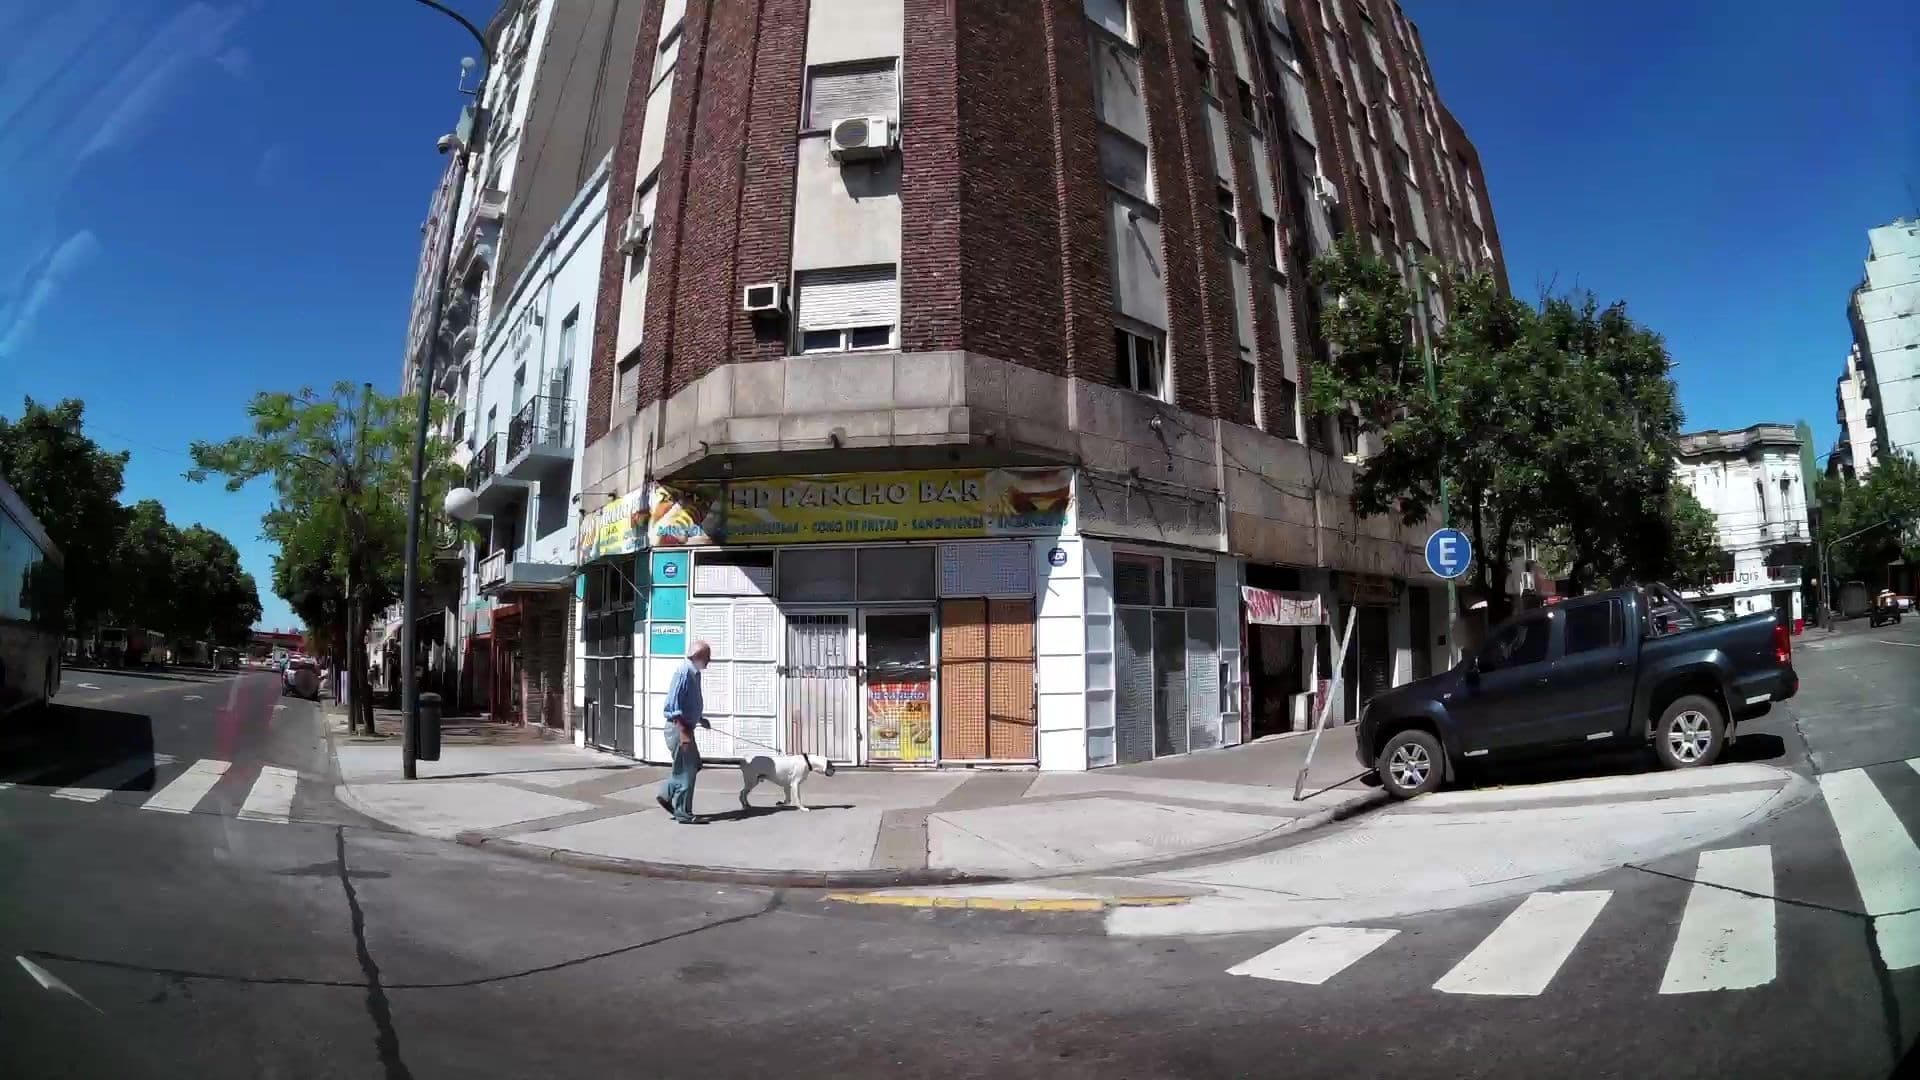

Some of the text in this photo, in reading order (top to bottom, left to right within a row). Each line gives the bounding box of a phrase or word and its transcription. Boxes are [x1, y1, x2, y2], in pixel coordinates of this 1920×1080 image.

[782, 481, 911, 508] PANCHO
[918, 479, 981, 504] BAR
[1439, 537, 1457, 566] E
